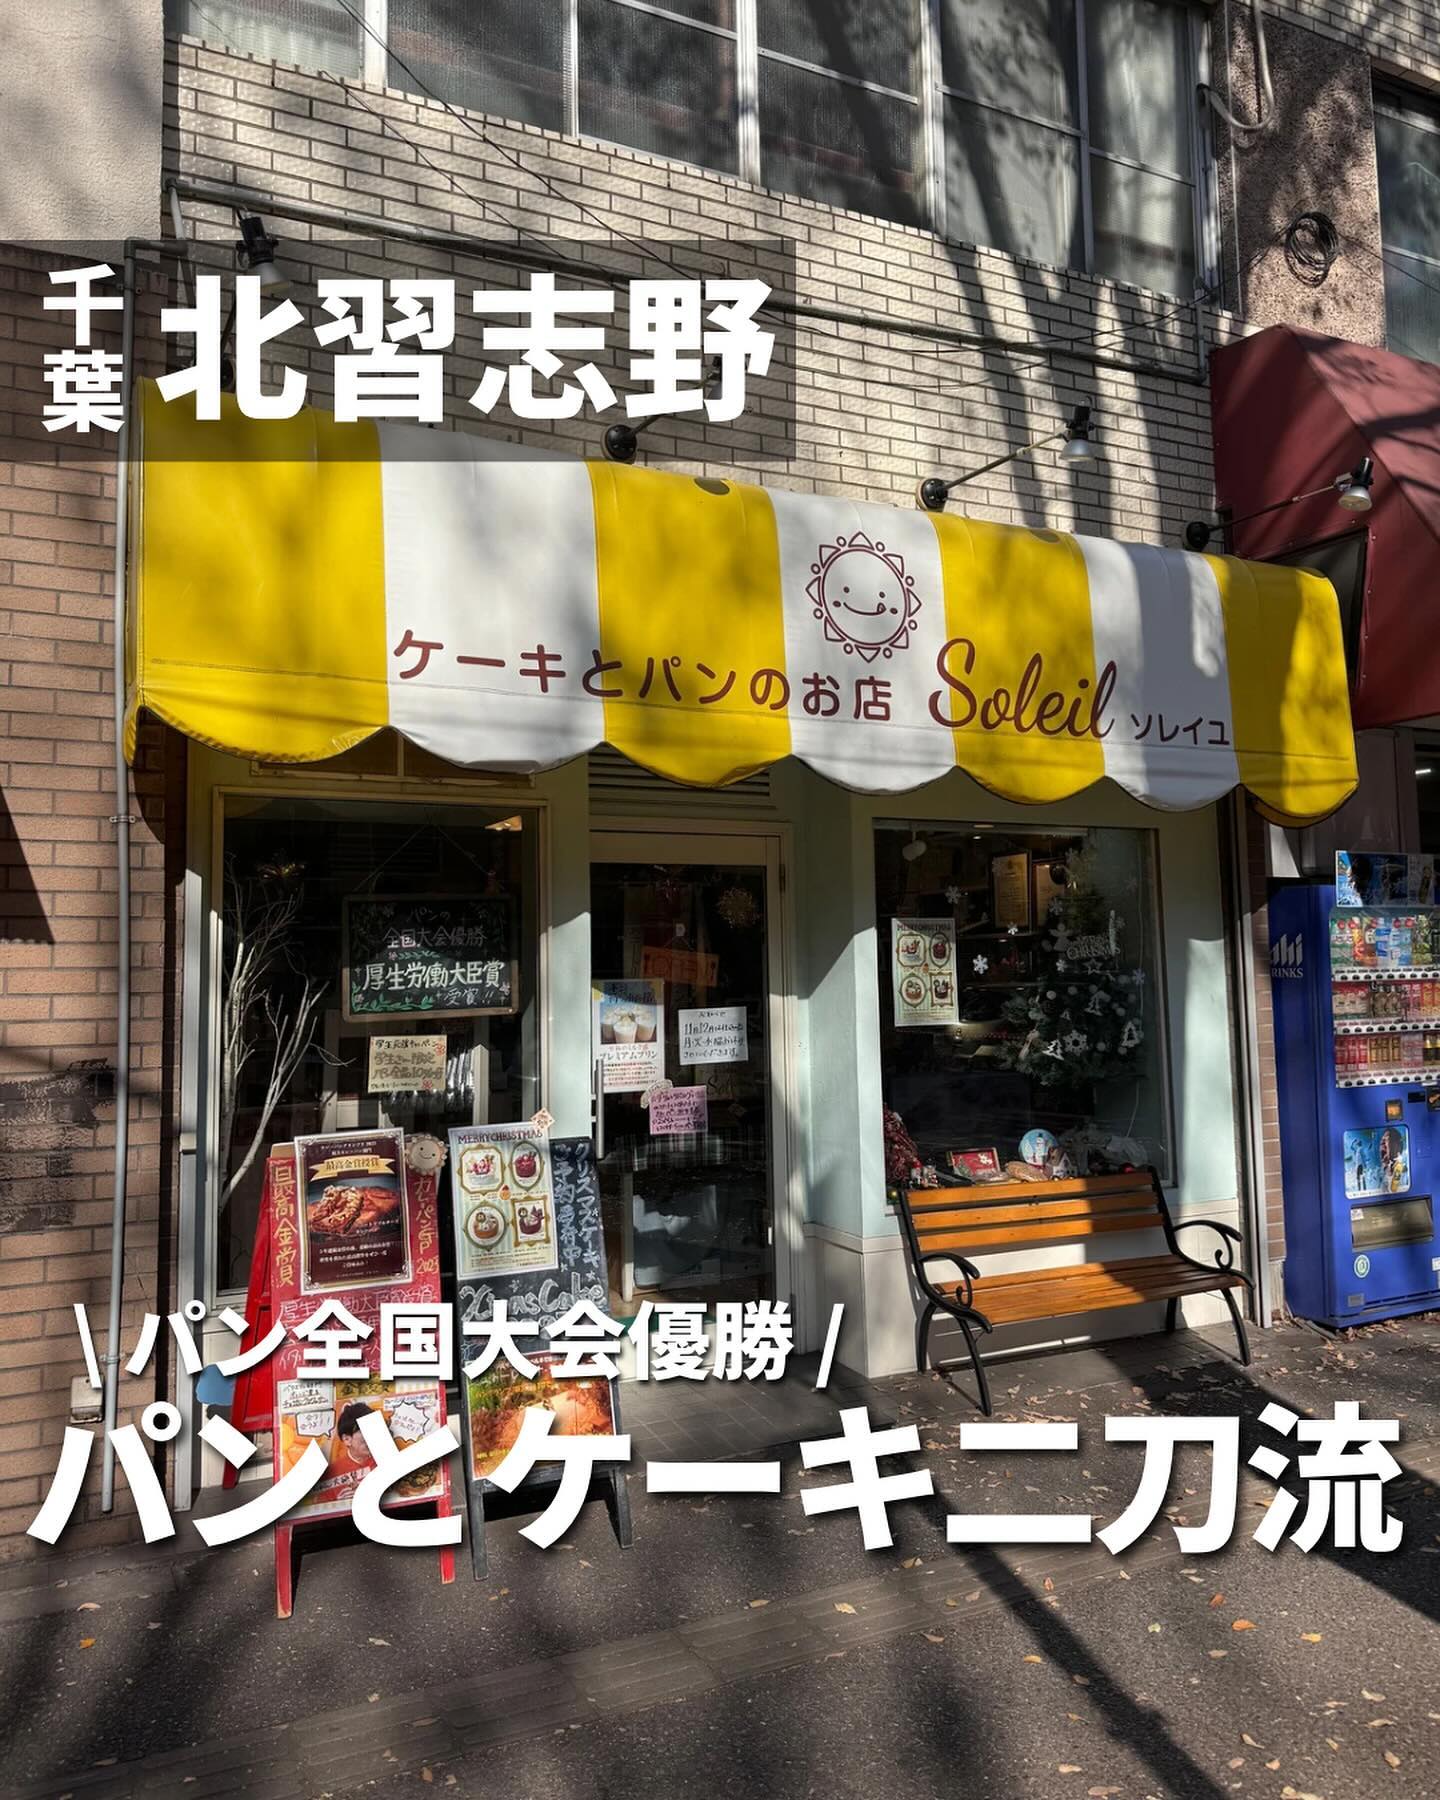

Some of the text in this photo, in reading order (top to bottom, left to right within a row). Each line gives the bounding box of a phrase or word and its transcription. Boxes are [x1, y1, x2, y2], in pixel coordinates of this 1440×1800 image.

[394, 630, 892, 721] ケーキとパンのお店
[928, 638, 1118, 740] Soleil
[1131, 713, 1231, 747] ソレイユ
[383, 926, 488, 949] 全国大会優勝
[363, 959, 505, 992] 厚生労働大臣賞
[1271, 967, 1304, 978] RINKS
